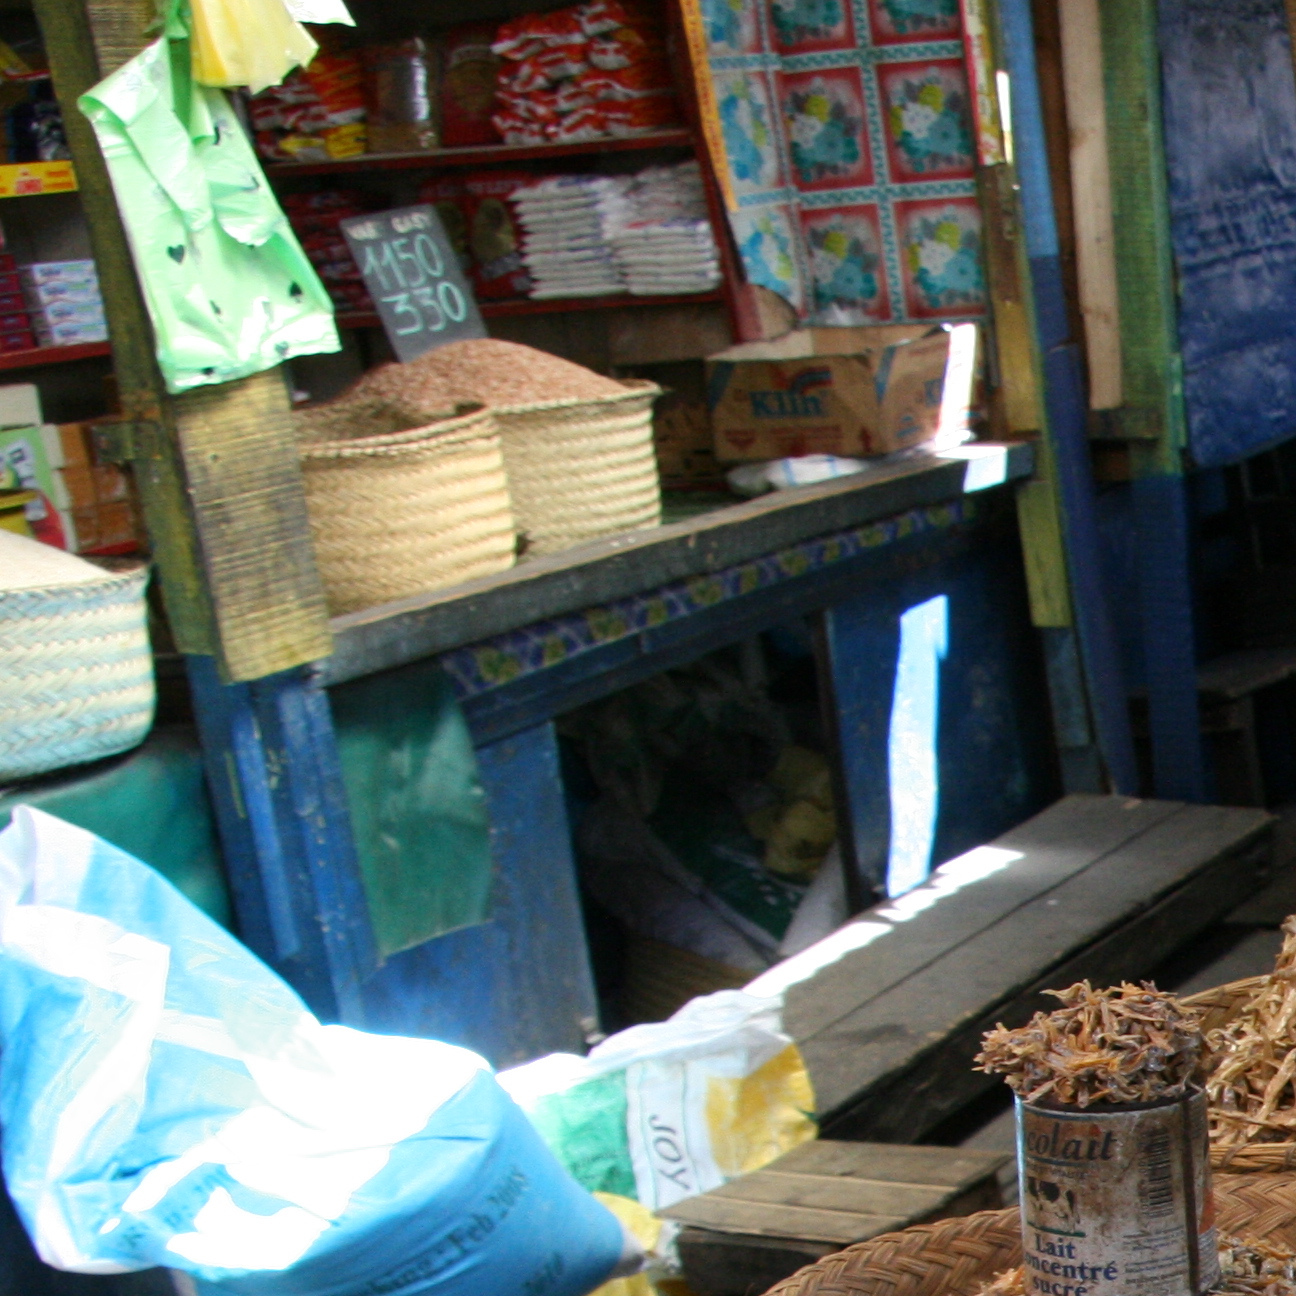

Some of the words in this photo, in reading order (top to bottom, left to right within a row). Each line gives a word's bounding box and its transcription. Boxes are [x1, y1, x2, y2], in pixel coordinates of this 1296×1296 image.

[363, 233, 444, 291] 1150
[648, 1112, 693, 1193] JOY
[1033, 1232, 1077, 1260] Lait
